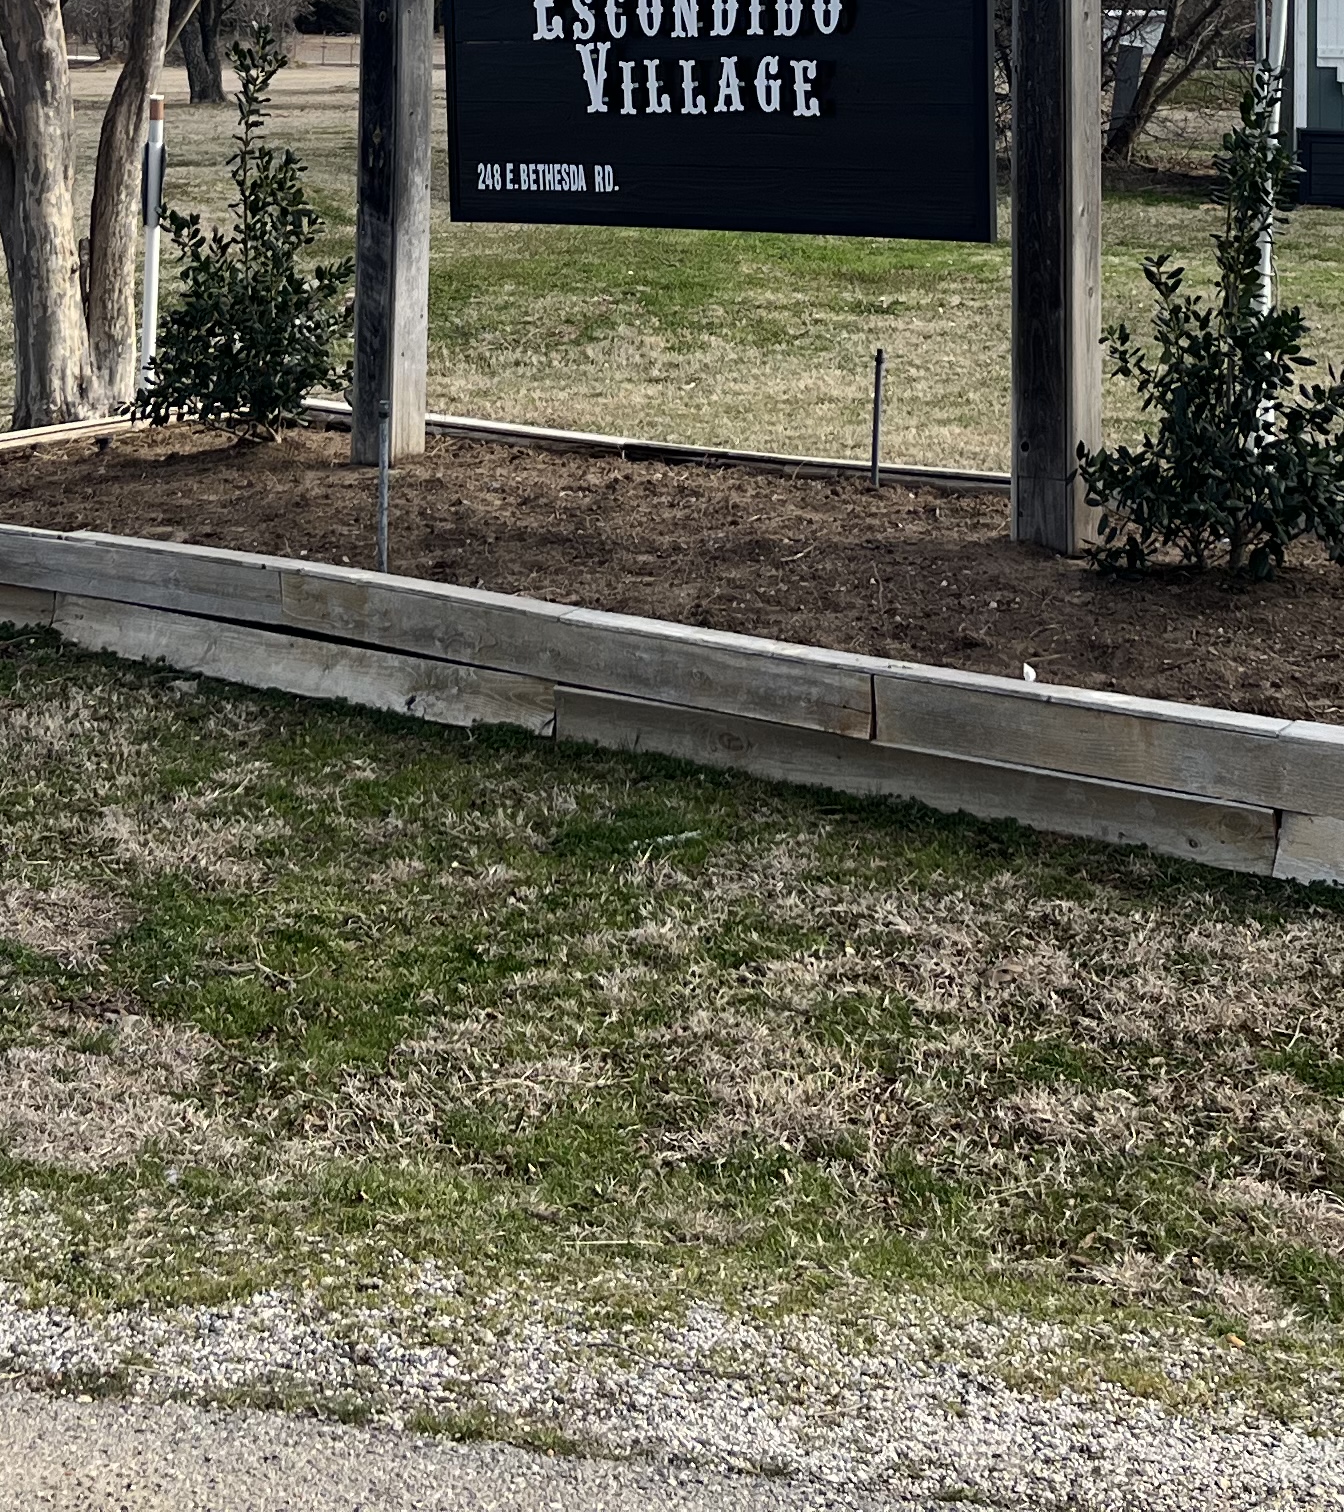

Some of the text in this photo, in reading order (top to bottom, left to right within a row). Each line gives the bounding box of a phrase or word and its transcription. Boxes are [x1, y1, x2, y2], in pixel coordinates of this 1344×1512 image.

[575, 41, 822, 117] VILLAGE
[477, 162, 502, 191] 248
[594, 164, 620, 193] RD.
